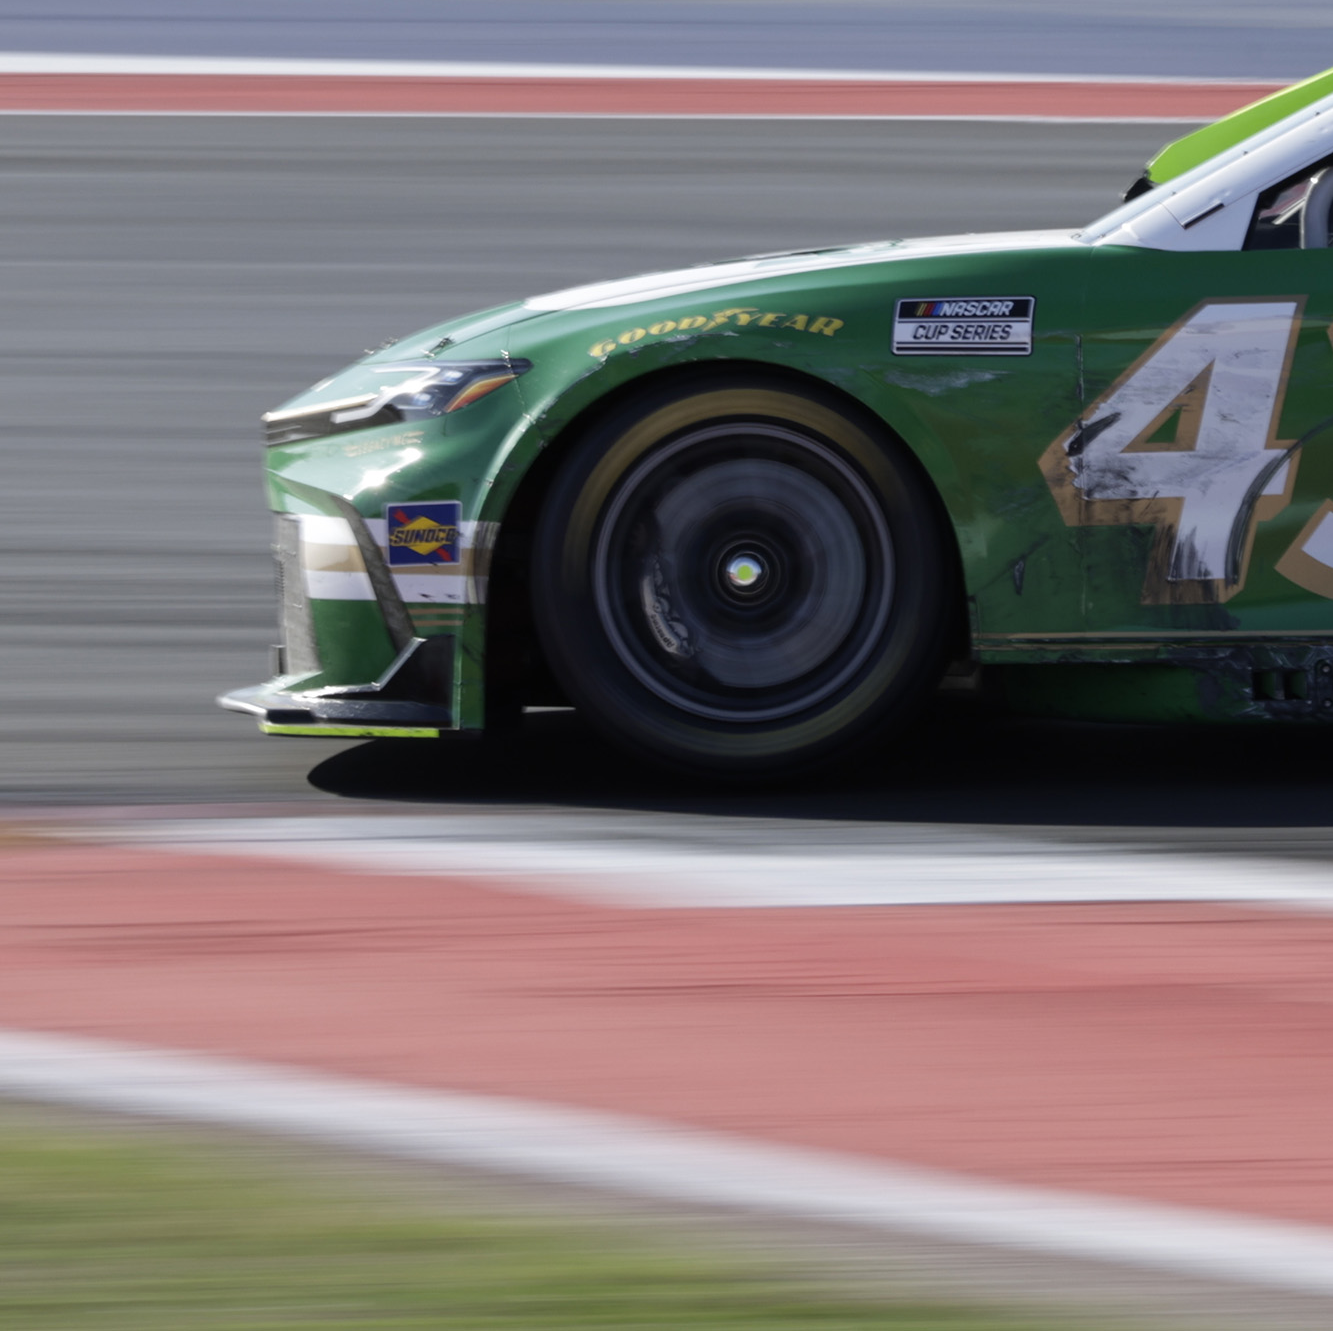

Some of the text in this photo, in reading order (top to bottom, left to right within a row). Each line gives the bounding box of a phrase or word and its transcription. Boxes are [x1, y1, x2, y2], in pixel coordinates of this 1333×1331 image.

[940, 301, 1015, 317] NASCAR
[588, 307, 846, 359] GOODYEAR
[912, 325, 1013, 341] CUP SERIES
[391, 527, 462, 545] SUNOCO
